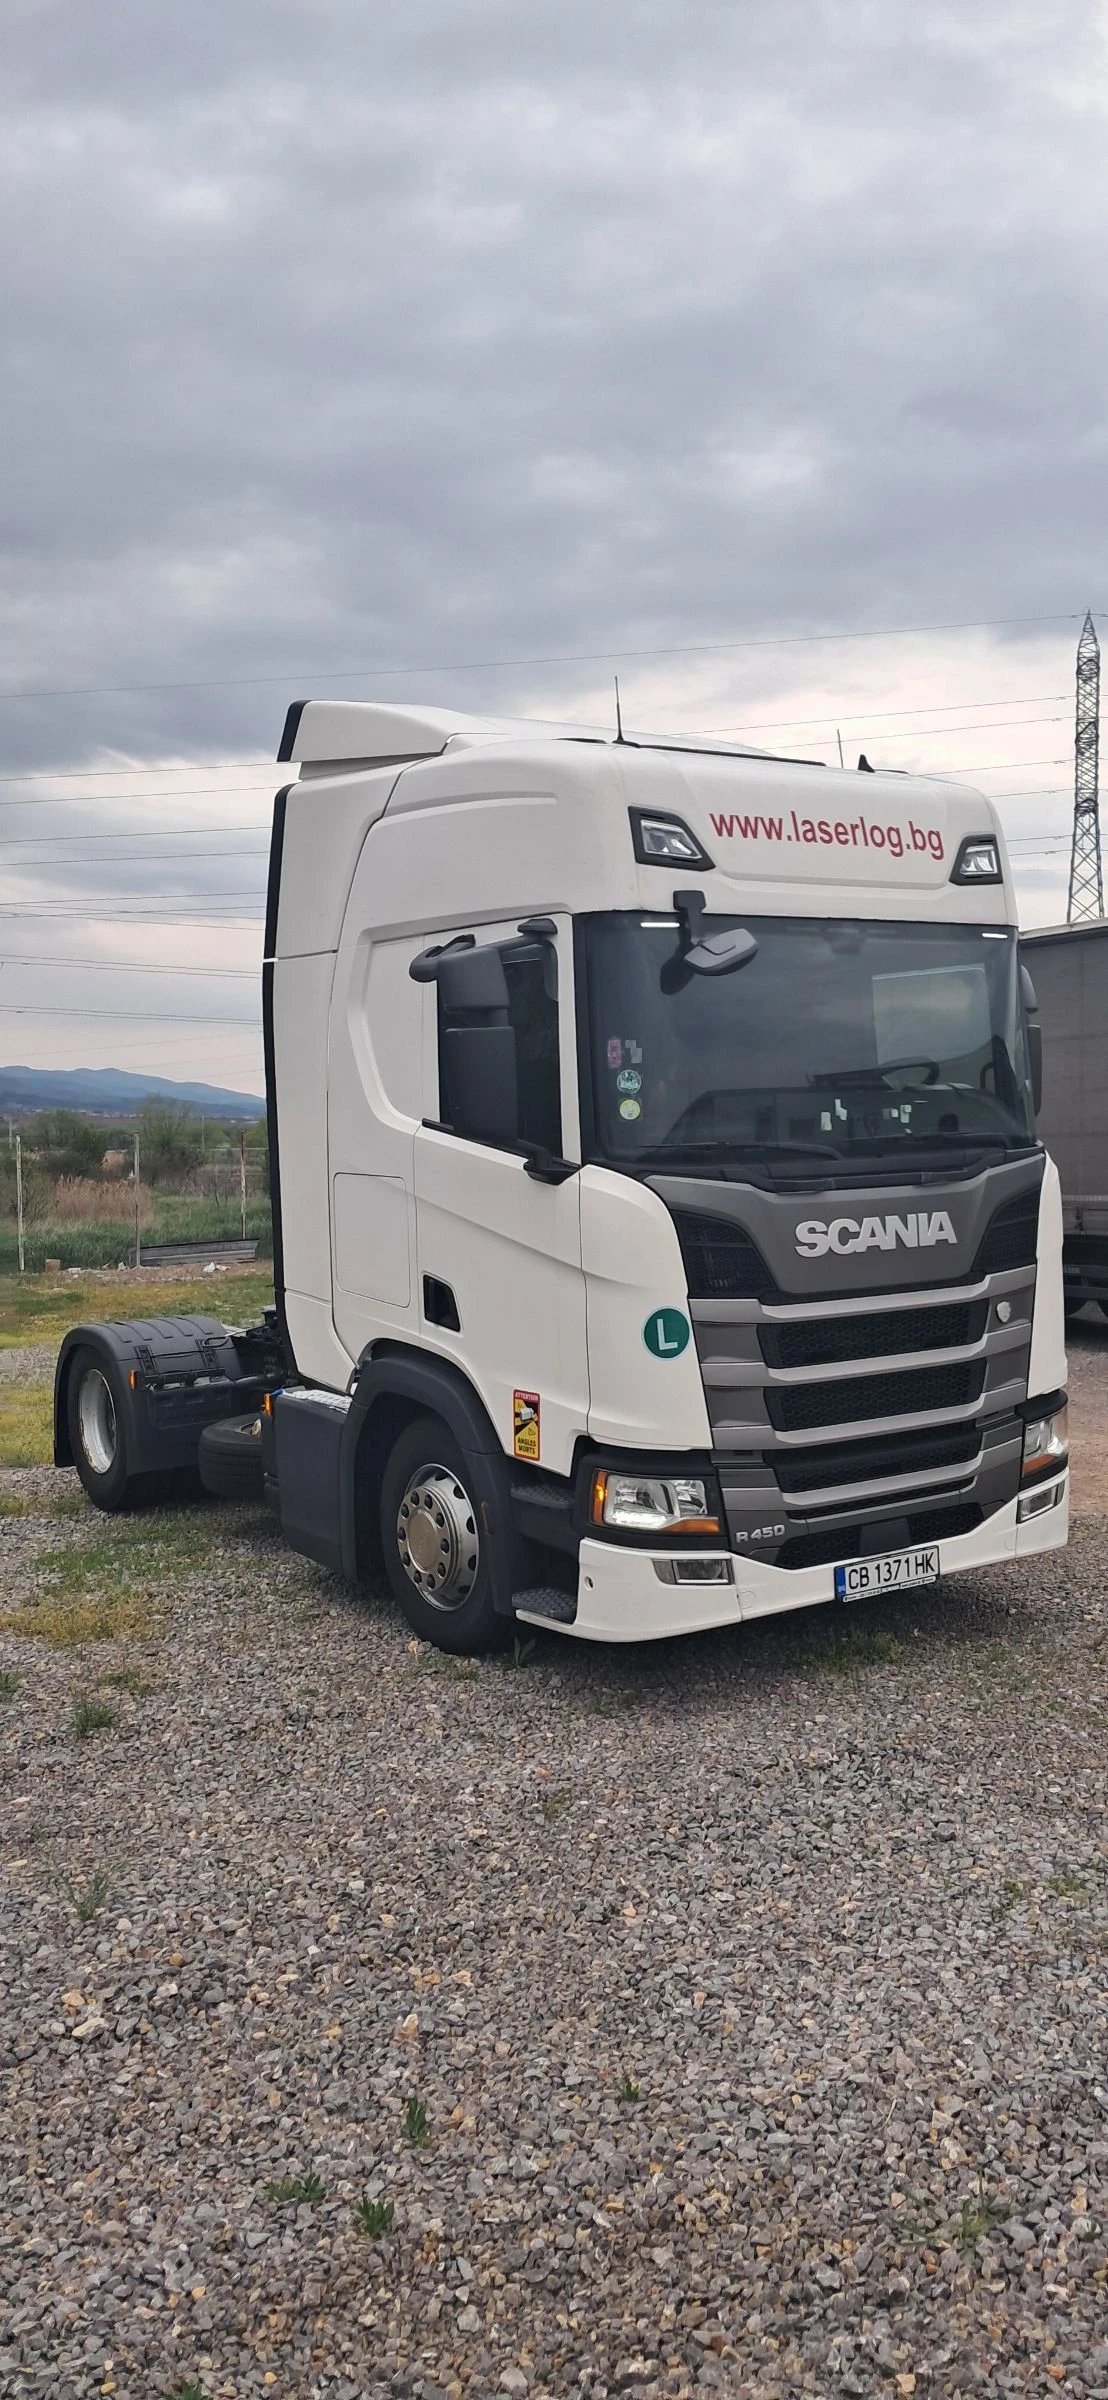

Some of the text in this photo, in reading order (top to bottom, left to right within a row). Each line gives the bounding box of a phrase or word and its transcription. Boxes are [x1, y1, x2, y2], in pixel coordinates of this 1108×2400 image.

[709, 811, 945, 860] www.laserlog.bg
[794, 1211, 958, 1258] SCANIA
[656, 1318, 678, 1350] L
[517, 1437, 537, 1447] ANGLES
[518, 1445, 536, 1455] MORTS
[735, 1524, 785, 1543] R 450
